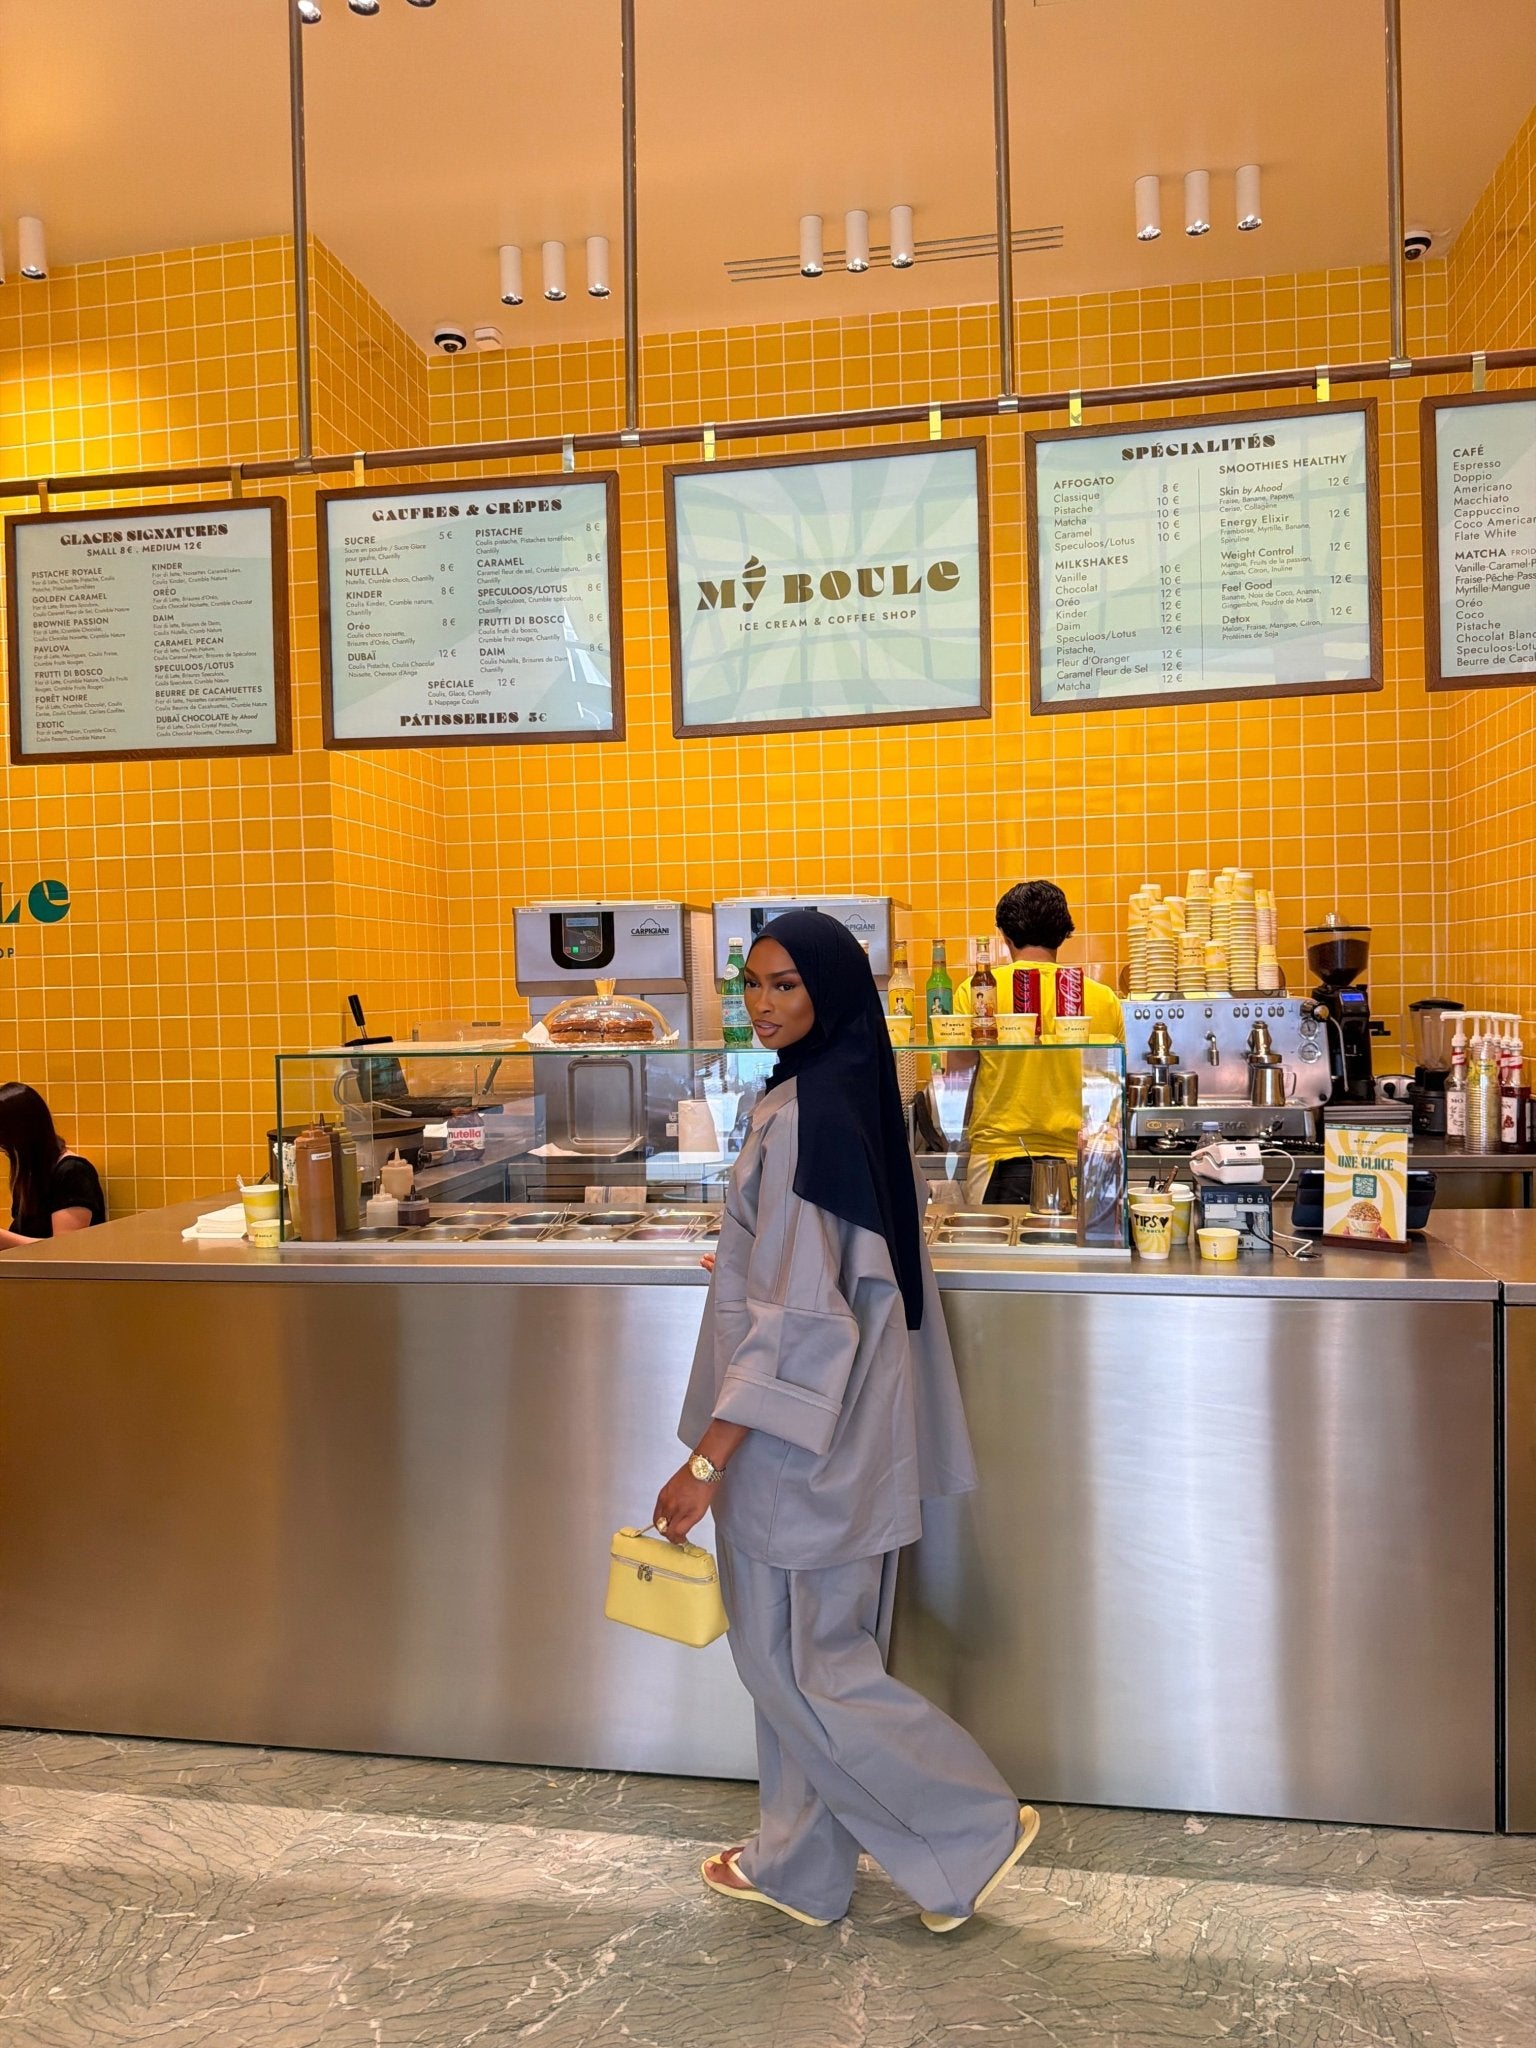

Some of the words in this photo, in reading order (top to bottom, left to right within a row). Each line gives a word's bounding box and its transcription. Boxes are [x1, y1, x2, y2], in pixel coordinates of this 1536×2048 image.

[1122, 433, 1276, 461] SPÉCIALITÉS
[1453, 444, 1484, 458] CAFÉ
[1219, 460, 1288, 475] SMOOTHIES
[1293, 454, 1347, 468] HEALTHY
[1453, 460, 1501, 472] Espresso
[1053, 476, 1115, 490] AFFOGATO
[1453, 472, 1492, 483] Doppio
[1219, 486, 1239, 496] Skin
[1242, 485, 1252, 496] by
[1254, 483, 1283, 493] Ahood
[1328, 477, 1339, 487] 12
[1454, 483, 1512, 494] Americano
[1053, 492, 1100, 504] Classique
[1162, 484, 1168, 493] 8
[1454, 494, 1509, 506] Macchiato
[372, 505, 460, 522] GAUFRES
[466, 504, 480, 516] &
[486, 499, 562, 515] CRÊPES
[1054, 504, 1093, 515] Pistache
[1157, 497, 1169, 506] 10
[1454, 505, 1520, 518] Cappuccino
[1054, 517, 1087, 527] Matcha
[1157, 509, 1169, 518] 10
[1220, 516, 1258, 528] Energy
[1261, 513, 1290, 524] Elixir
[1329, 509, 1340, 519] 12
[1054, 528, 1092, 540] Caramel
[1157, 521, 1169, 530] 10
[1454, 520, 1483, 530] Coco
[60, 531, 123, 546] GLACES
[126, 524, 229, 542] SIGNATURES
[344, 536, 376, 545] SUCRE
[439, 532, 445, 540] 5
[475, 527, 523, 538] PISTACHE
[1454, 531, 1480, 541] Flate
[1484, 528, 1517, 539] White
[1054, 538, 1135, 553] Speculoos/Lotus
[1157, 533, 1169, 542] 10
[87, 547, 117, 557] SMALL
[142, 543, 181, 553] MEDIUM
[1221, 549, 1256, 561] Weight
[1258, 545, 1294, 558] Control
[1329, 542, 1340, 552] 12
[1455, 548, 1507, 560] MATCHA
[151, 562, 183, 571] KINDER
[476, 557, 524, 568] CARAMEL
[1055, 555, 1129, 570] MILKSHAKES
[31, 569, 69, 578] PISTACHE
[71, 567, 102, 576] ROYALE
[345, 567, 389, 577] NUTELLA
[440, 564, 446, 572] 8
[1055, 572, 1088, 583] Vanille
[1055, 583, 1098, 595] Chocolat
[1221, 582, 1242, 593] Feel
[1244, 579, 1273, 591] Good
[1330, 575, 1341, 584] 12
[346, 590, 383, 600] KINDER
[441, 587, 447, 595] 8
[477, 584, 568, 598] SPECULOOS/LOTUS
[32, 594, 67, 604] GOLDEN
[69, 592, 108, 602] CARAMEL
[1055, 597, 1081, 607] Oréo
[1455, 597, 1483, 608] Oréo
[152, 614, 175, 622] DAIM
[739, 622, 759, 632] ICE
[765, 618, 808, 630] CREAM
[814, 617, 822, 626] &
[828, 612, 876, 625] COFFEE
[882, 609, 917, 621] SHOP
[1056, 609, 1087, 620] Kinder
[1222, 615, 1250, 625] Detox
[1331, 606, 1342, 616] 12
[1456, 610, 1484, 620] Coco
[33, 619, 71, 629] BROWNIE
[73, 617, 109, 626] PASSION
[347, 621, 371, 631] Oréo
[478, 617, 511, 627] FRUTTI
[515, 616, 525, 625] DI
[529, 615, 565, 625] BOSCO
[1056, 622, 1081, 632] Daim
[1456, 620, 1501, 632] Pistache
[154, 638, 193, 648] CARAMEL
[195, 637, 224, 645] PECAN
[1056, 630, 1137, 646] Speculoos/Lotus
[1456, 632, 1504, 644] Chocolat
[34, 645, 70, 653] PAVLOVA
[479, 648, 506, 656] DAIM
[1056, 643, 1096, 656] Pistache,
[347, 650, 377, 662] DUBAÏ
[1457, 657, 1490, 667] Beurre
[1492, 654, 1506, 664] de
[154, 661, 235, 673] SPECULOOS/LOTUS
[1056, 658, 1079, 668] Fleur
[35, 670, 61, 679] FRUTTI
[74, 668, 104, 677] BOSCO
[1056, 667, 1093, 680] Caramel
[1095, 666, 1117, 677] Fleur
[1119, 665, 1132, 675] de
[1134, 663, 1148, 673] Sel
[427, 679, 474, 689] SPÉCIALE
[497, 678, 508, 687] 12
[1056, 681, 1091, 692] Matcha
[155, 689, 186, 698] BEURRE
[189, 688, 200, 696] DE
[202, 685, 263, 696] CACAHUETTES
[35, 694, 60, 703] FORÊT
[62, 693, 88, 702] NOIRE
[181, 713, 229, 722] CHOCOLATE
[400, 711, 519, 727] PÂTISSERIES
[36, 720, 65, 729] EXOTIC
[631, 927, 670, 935] CARPIGIANI
[448, 1129, 481, 1139] nutella
[1134, 1213, 1159, 1228] TIPS
